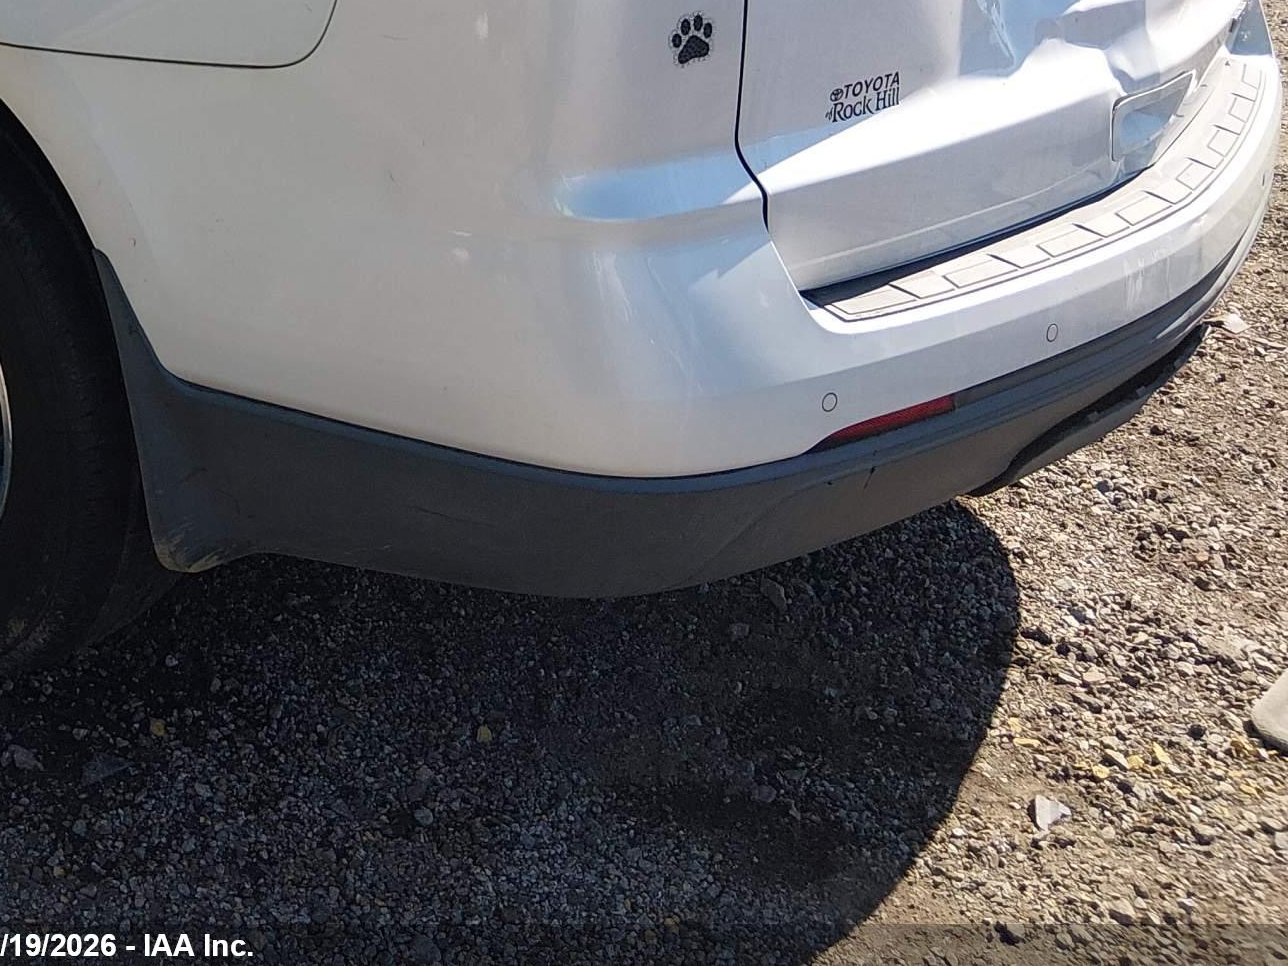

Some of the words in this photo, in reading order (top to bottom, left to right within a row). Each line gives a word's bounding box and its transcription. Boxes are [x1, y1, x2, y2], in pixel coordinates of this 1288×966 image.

[843, 71, 900, 99] TOYOTA
[832, 96, 874, 123] Rock
[875, 86, 900, 111] Hill
